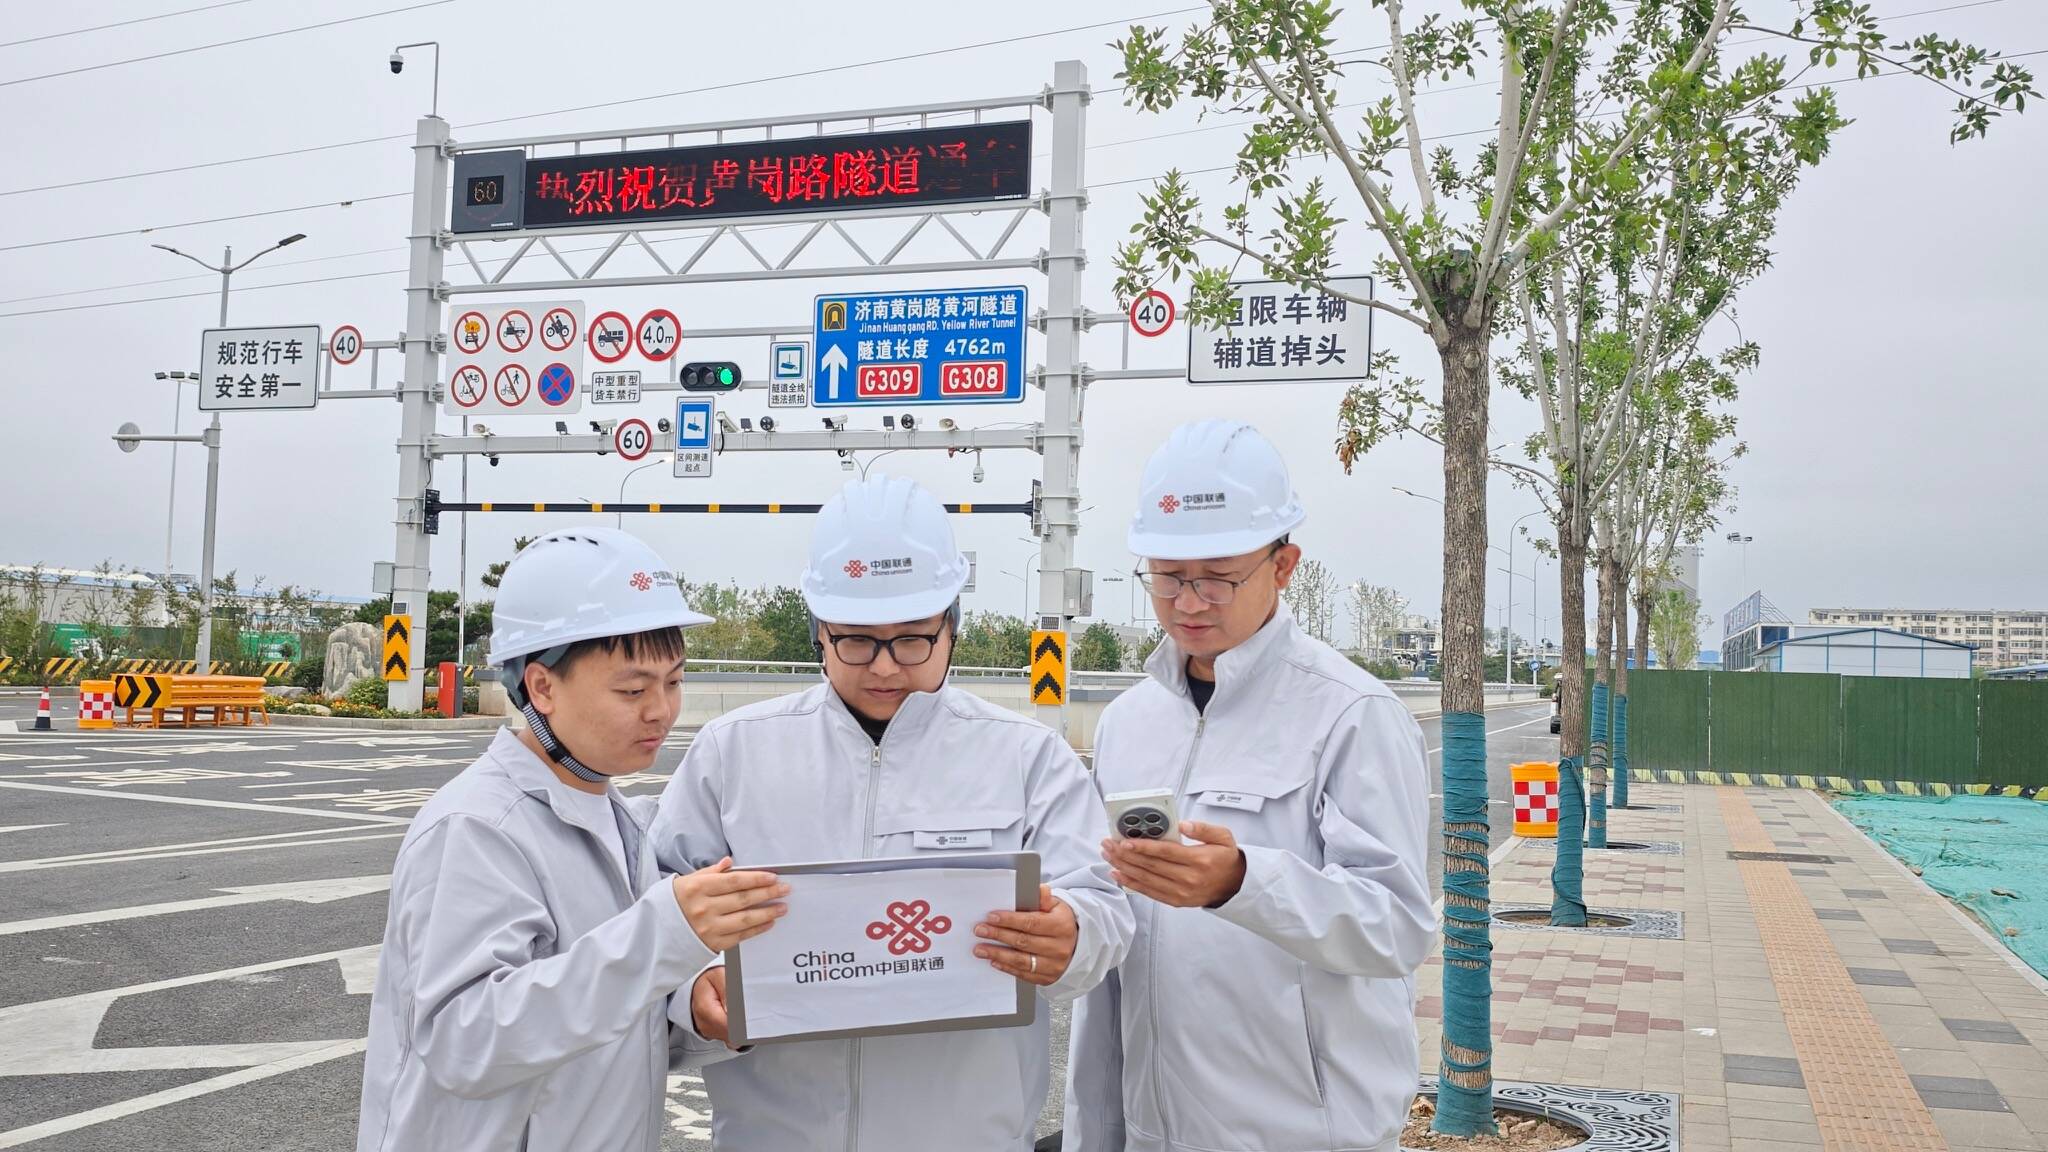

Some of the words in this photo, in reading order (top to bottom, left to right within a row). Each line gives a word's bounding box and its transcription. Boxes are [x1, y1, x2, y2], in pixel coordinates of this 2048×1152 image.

[474, 181, 497, 202] 60
[855, 294, 1017, 321] 济南黄岗路黄河隧道
[1138, 304, 1166, 324] 40
[1222, 293, 1347, 327] 限车辆
[643, 325, 674, 344] 4.0m
[859, 322, 881, 334] Jinan
[942, 320, 967, 330] Yellow
[969, 320, 989, 329] River
[991, 317, 1017, 328] Tunnel
[218, 339, 303, 365] 规范行车
[336, 336, 356, 354] 40
[857, 338, 929, 361] 隧道长度
[945, 338, 1006, 356] 4762m
[1213, 334, 1347, 369] 辅道掉头
[215, 373, 302, 399] 安全第一
[595, 374, 639, 388] 中型重型
[772, 383, 806, 393] 隧道全线
[865, 368, 914, 391] G309
[949, 367, 999, 390] G308
[595, 387, 638, 401] 货车禁行
[771, 394, 805, 405] 违法抓拍
[623, 430, 646, 449] 60
[677, 453, 709, 462] 区间测速
[685, 463, 701, 472] 起点
[870, 557, 912, 570] 中国联通
[793, 950, 855, 968] China
[876, 956, 945, 976] 中国联通
[796, 964, 874, 984] unicom
